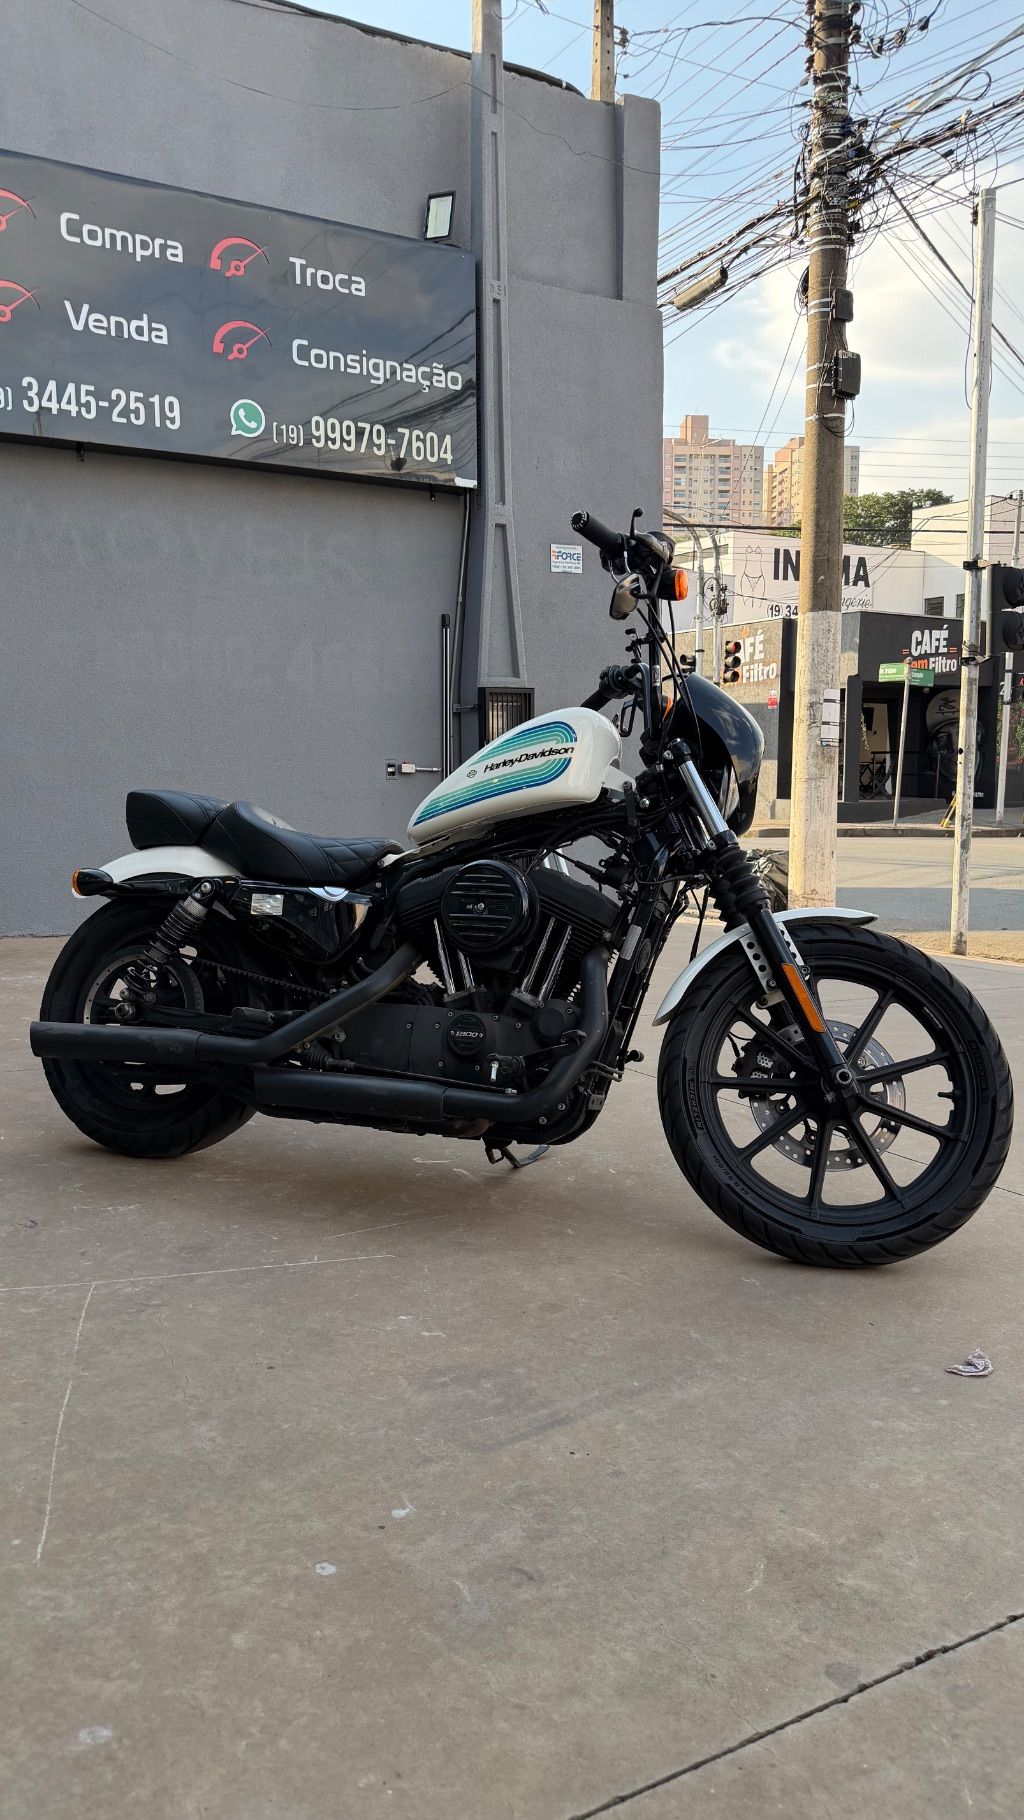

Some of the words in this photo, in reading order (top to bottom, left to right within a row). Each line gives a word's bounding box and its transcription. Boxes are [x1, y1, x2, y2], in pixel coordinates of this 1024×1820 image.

[60, 212, 184, 263] Compra
[289, 256, 366, 297] Troca
[63, 300, 169, 345] Venda
[292, 338, 463, 393] Consignação
[22, 376, 182, 430] 3445-2519
[272, 421, 304, 447] (19)
[311, 415, 454, 465] 99979-7604
[767, 603, 783, 618] (19)
[785, 605, 799, 618] 34
[734, 629, 765, 664] AFÉ
[911, 624, 949, 656] CAFÉ
[742, 662, 778, 684] Filtro
[928, 656, 957, 673] Filtro
[483, 746, 575, 774] Harley-Davidson
